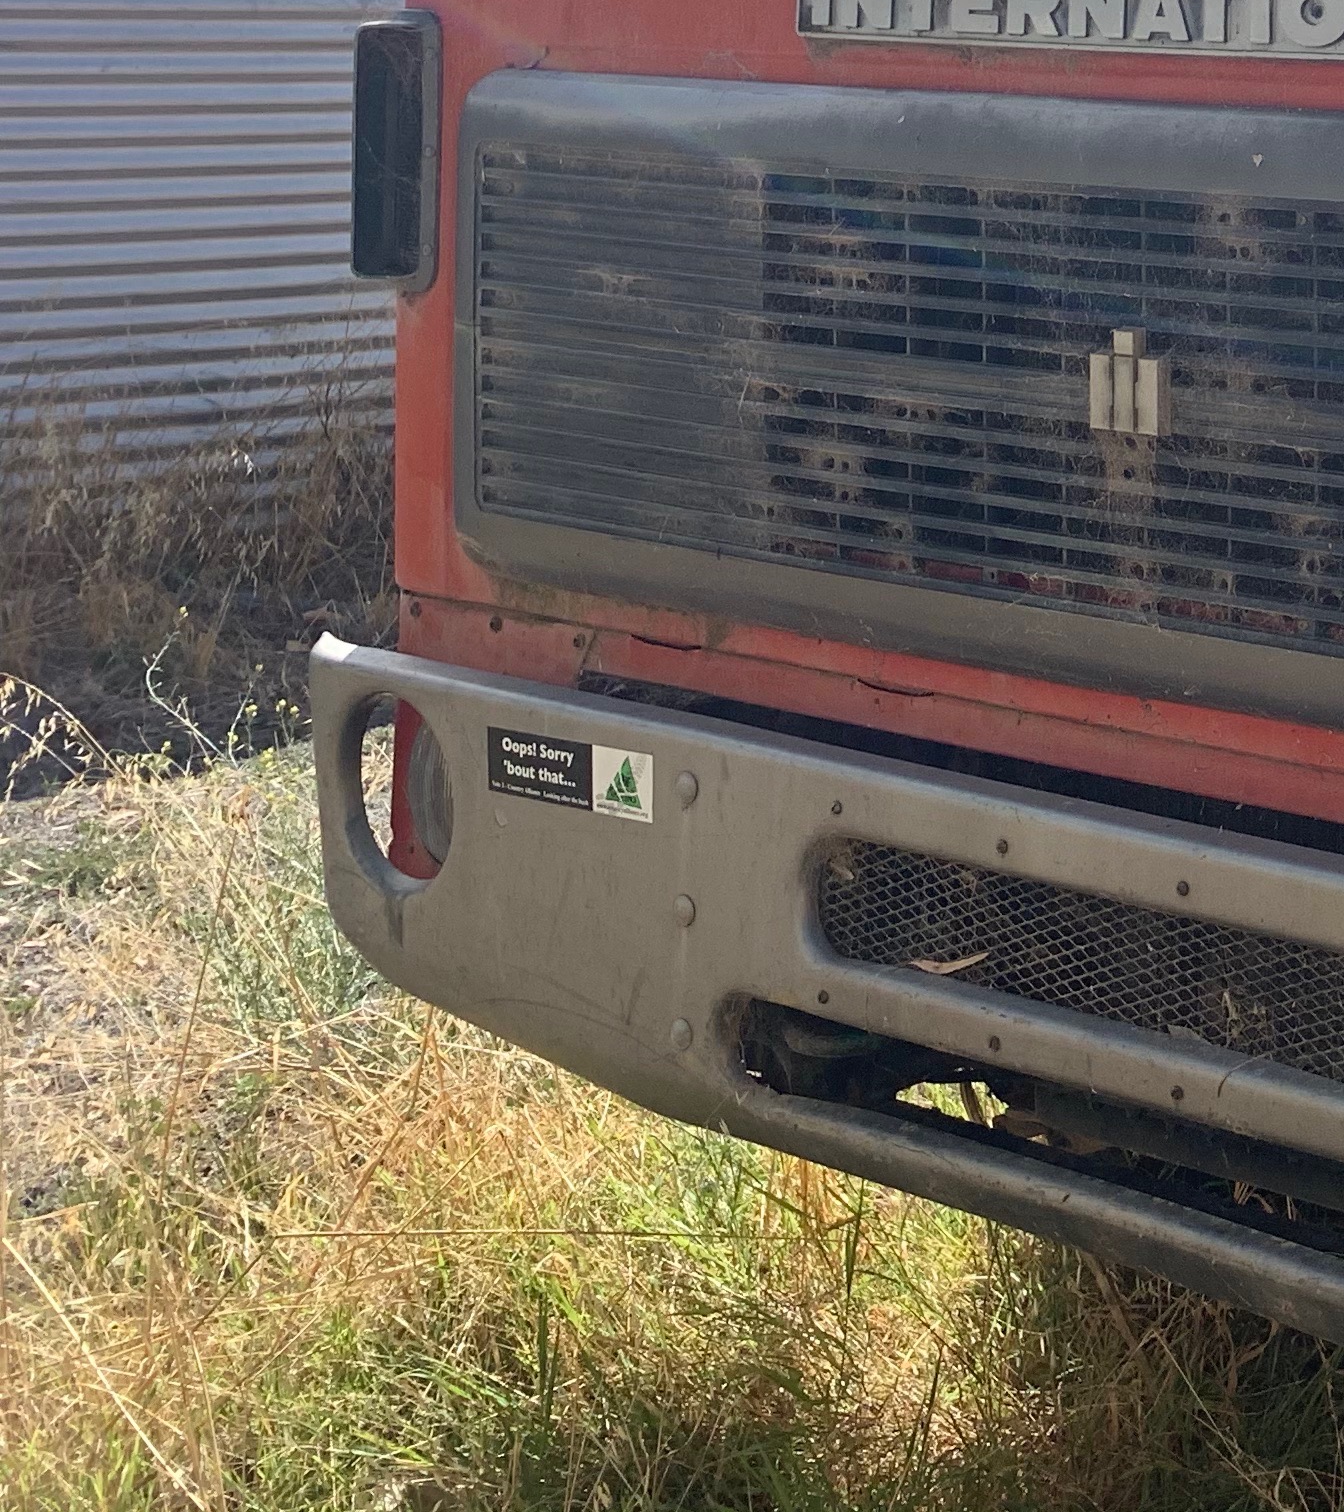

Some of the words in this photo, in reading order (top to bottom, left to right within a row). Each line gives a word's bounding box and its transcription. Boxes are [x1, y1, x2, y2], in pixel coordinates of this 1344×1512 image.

[502, 737, 537, 758] Oops!
[539, 743, 574, 768] Sorry
[503, 759, 535, 780] 'bout
[537, 767, 577, 788] that...
